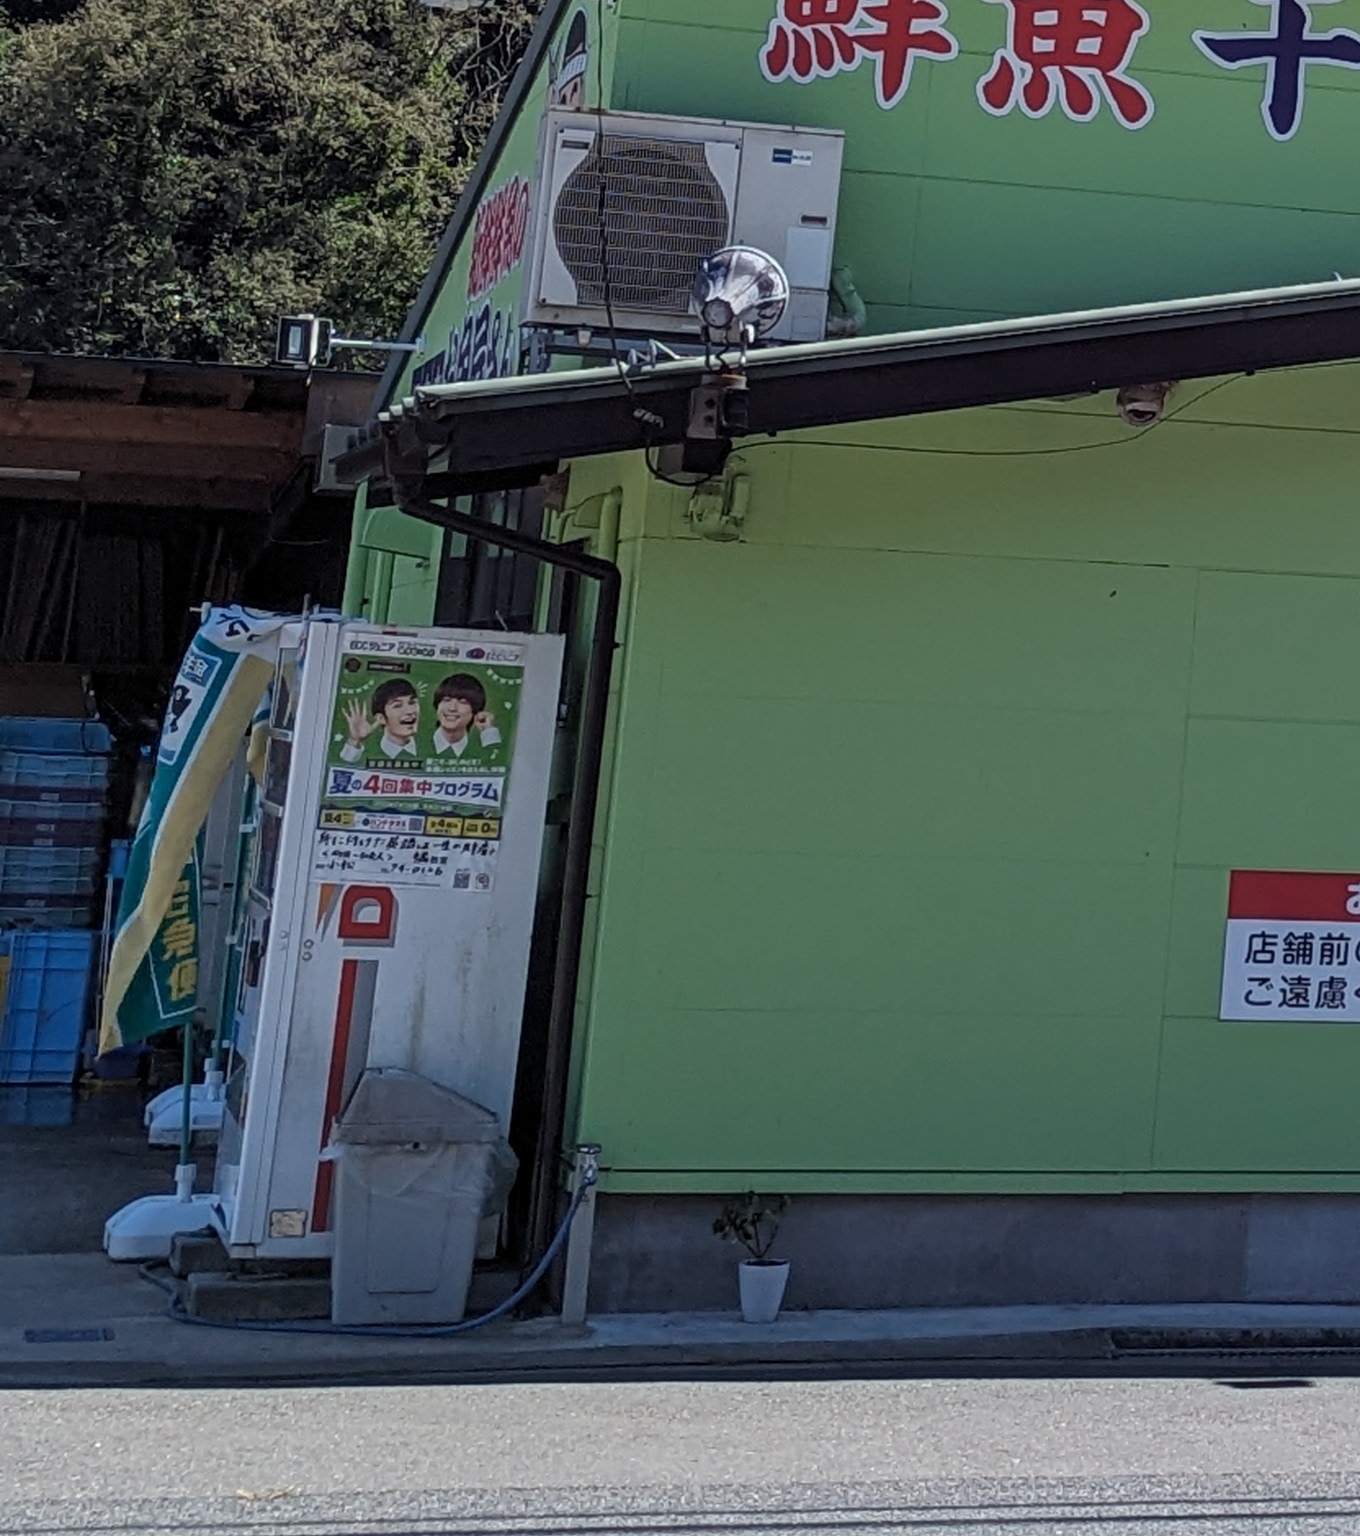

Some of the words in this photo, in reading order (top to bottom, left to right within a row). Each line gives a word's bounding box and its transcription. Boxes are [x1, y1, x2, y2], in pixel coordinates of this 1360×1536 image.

[328, 769, 499, 802] 夏の4回集中プログラム
